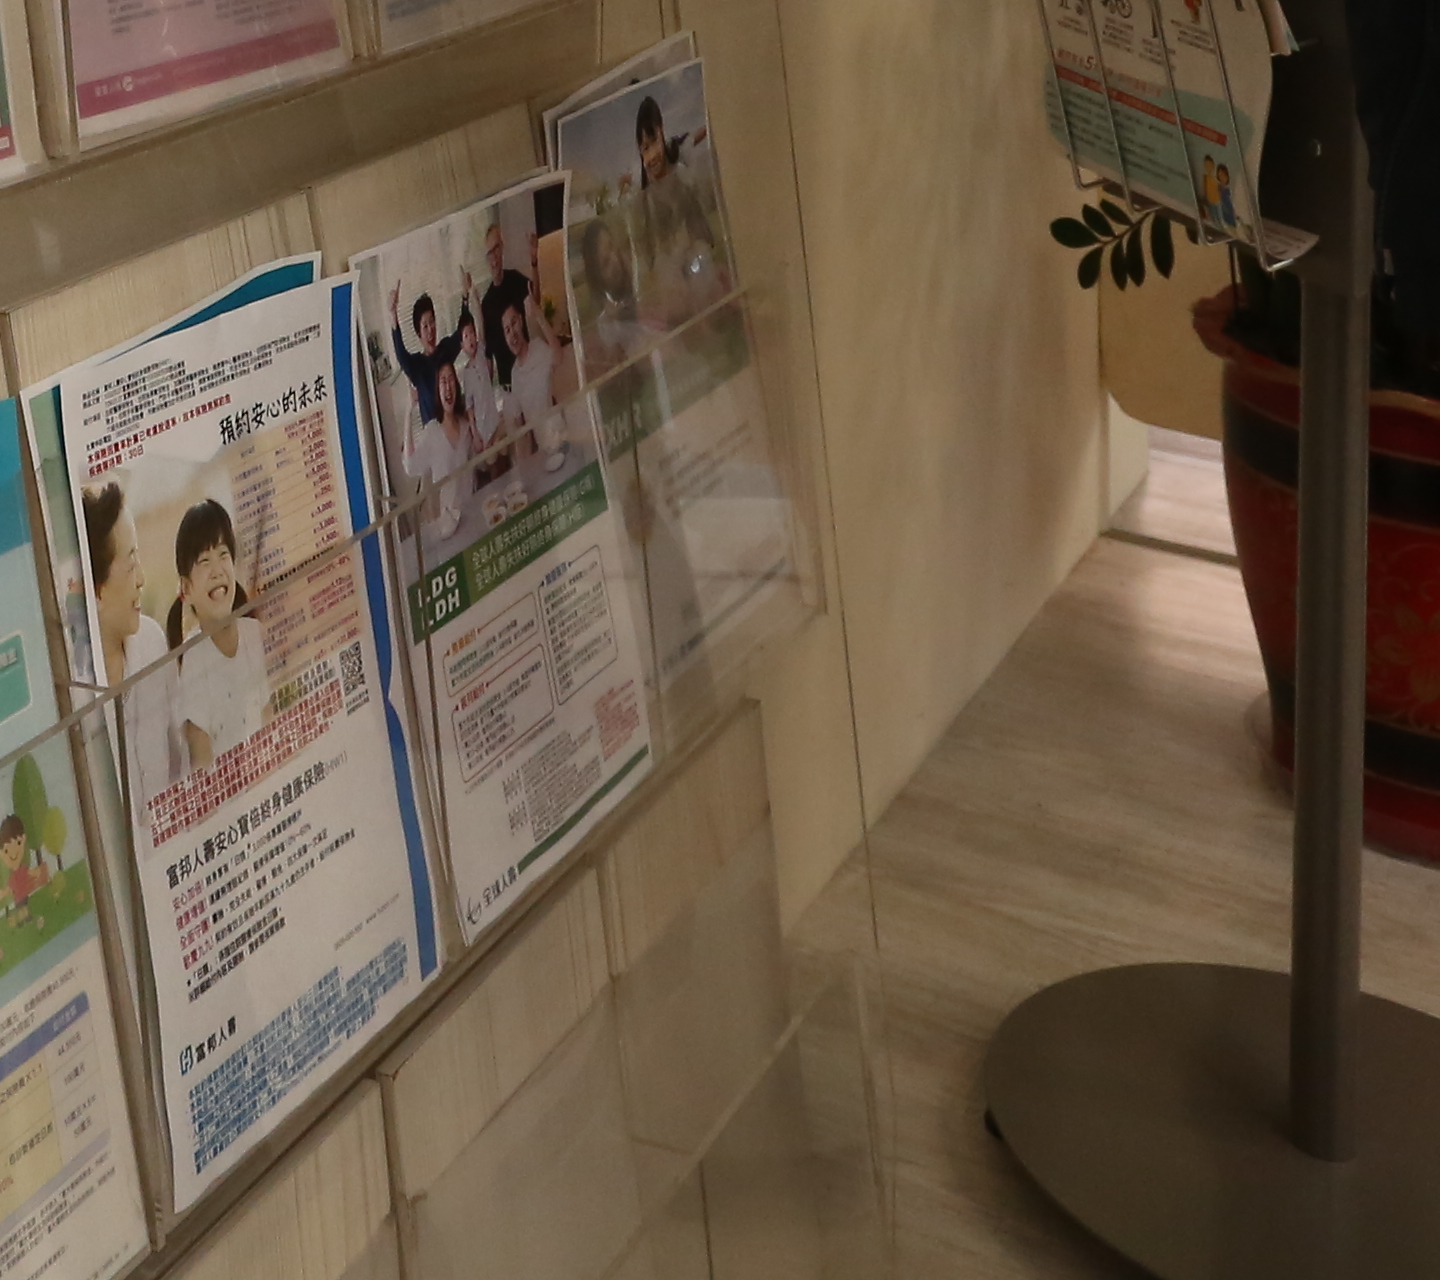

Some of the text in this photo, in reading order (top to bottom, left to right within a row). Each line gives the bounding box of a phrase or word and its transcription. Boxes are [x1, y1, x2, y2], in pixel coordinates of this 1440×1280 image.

[218, 374, 330, 448] 預約安心的未來
